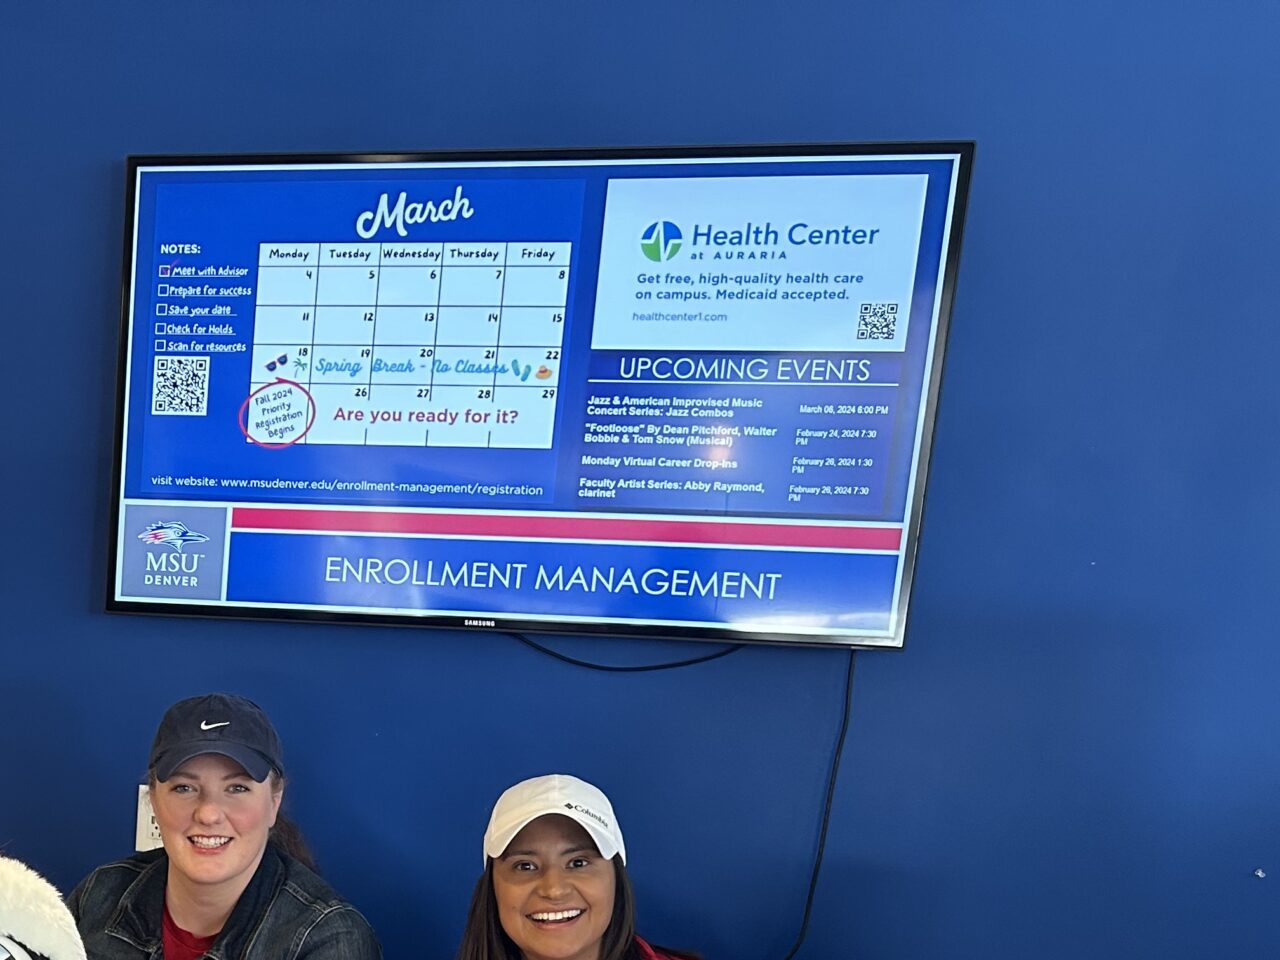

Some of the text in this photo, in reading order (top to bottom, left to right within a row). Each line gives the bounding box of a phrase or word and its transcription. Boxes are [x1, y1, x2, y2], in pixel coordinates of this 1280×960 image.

[356, 186, 474, 238] March
[692, 222, 880, 246] Health Center
[160, 244, 200, 254] NOTES:
[269, 249, 310, 261] Monday
[330, 249, 371, 261] Tuesday
[383, 249, 441, 262] Wednesday
[450, 249, 499, 262] Thursday
[522, 249, 555, 262] Friday
[690, 251, 787, 260] at AURARIA
[172, 266, 248, 276] Meet with Advisor
[637, 272, 864, 286] Get free, high-quality health care
[170, 285, 252, 298] Prepare for success
[636, 289, 850, 302] on campus. Medicaid accepted.
[168, 306, 230, 317] Save your date
[632, 312, 728, 322] healthcenter1.com
[167, 324, 233, 334] Check for Holds
[168, 341, 246, 351] Scan for resources
[316, 358, 508, 377] Spring Break No Classes
[620, 358, 870, 381] UPCOMING EVENTS
[255, 388, 293, 406] Fall 2024
[587, 396, 763, 408] Jazz American Improvised Music
[262, 402, 291, 416] Priority
[587, 406, 733, 418] Concert Series: Jazz Combos
[256, 410, 303, 430] Registration
[333, 408, 518, 426] Are you ready for it?
[268, 426, 294, 439] Begins
[647, 425, 661, 436] By
[663, 425, 689, 435] Dean
[692, 426, 741, 437] Pitchford,
[743, 426, 778, 436] Walter
[151, 474, 543, 496] visit website: www.msudenver.edu/enrollment-management/registration
[579, 478, 765, 493] Faculty Artist Series: Abby Raymond,
[146, 552, 199, 572] MSU
[144, 575, 198, 587] DENVER
[325, 556, 782, 600] ENROLLMENT MANAGEMENT
[574, 804, 608, 828] Columbia
